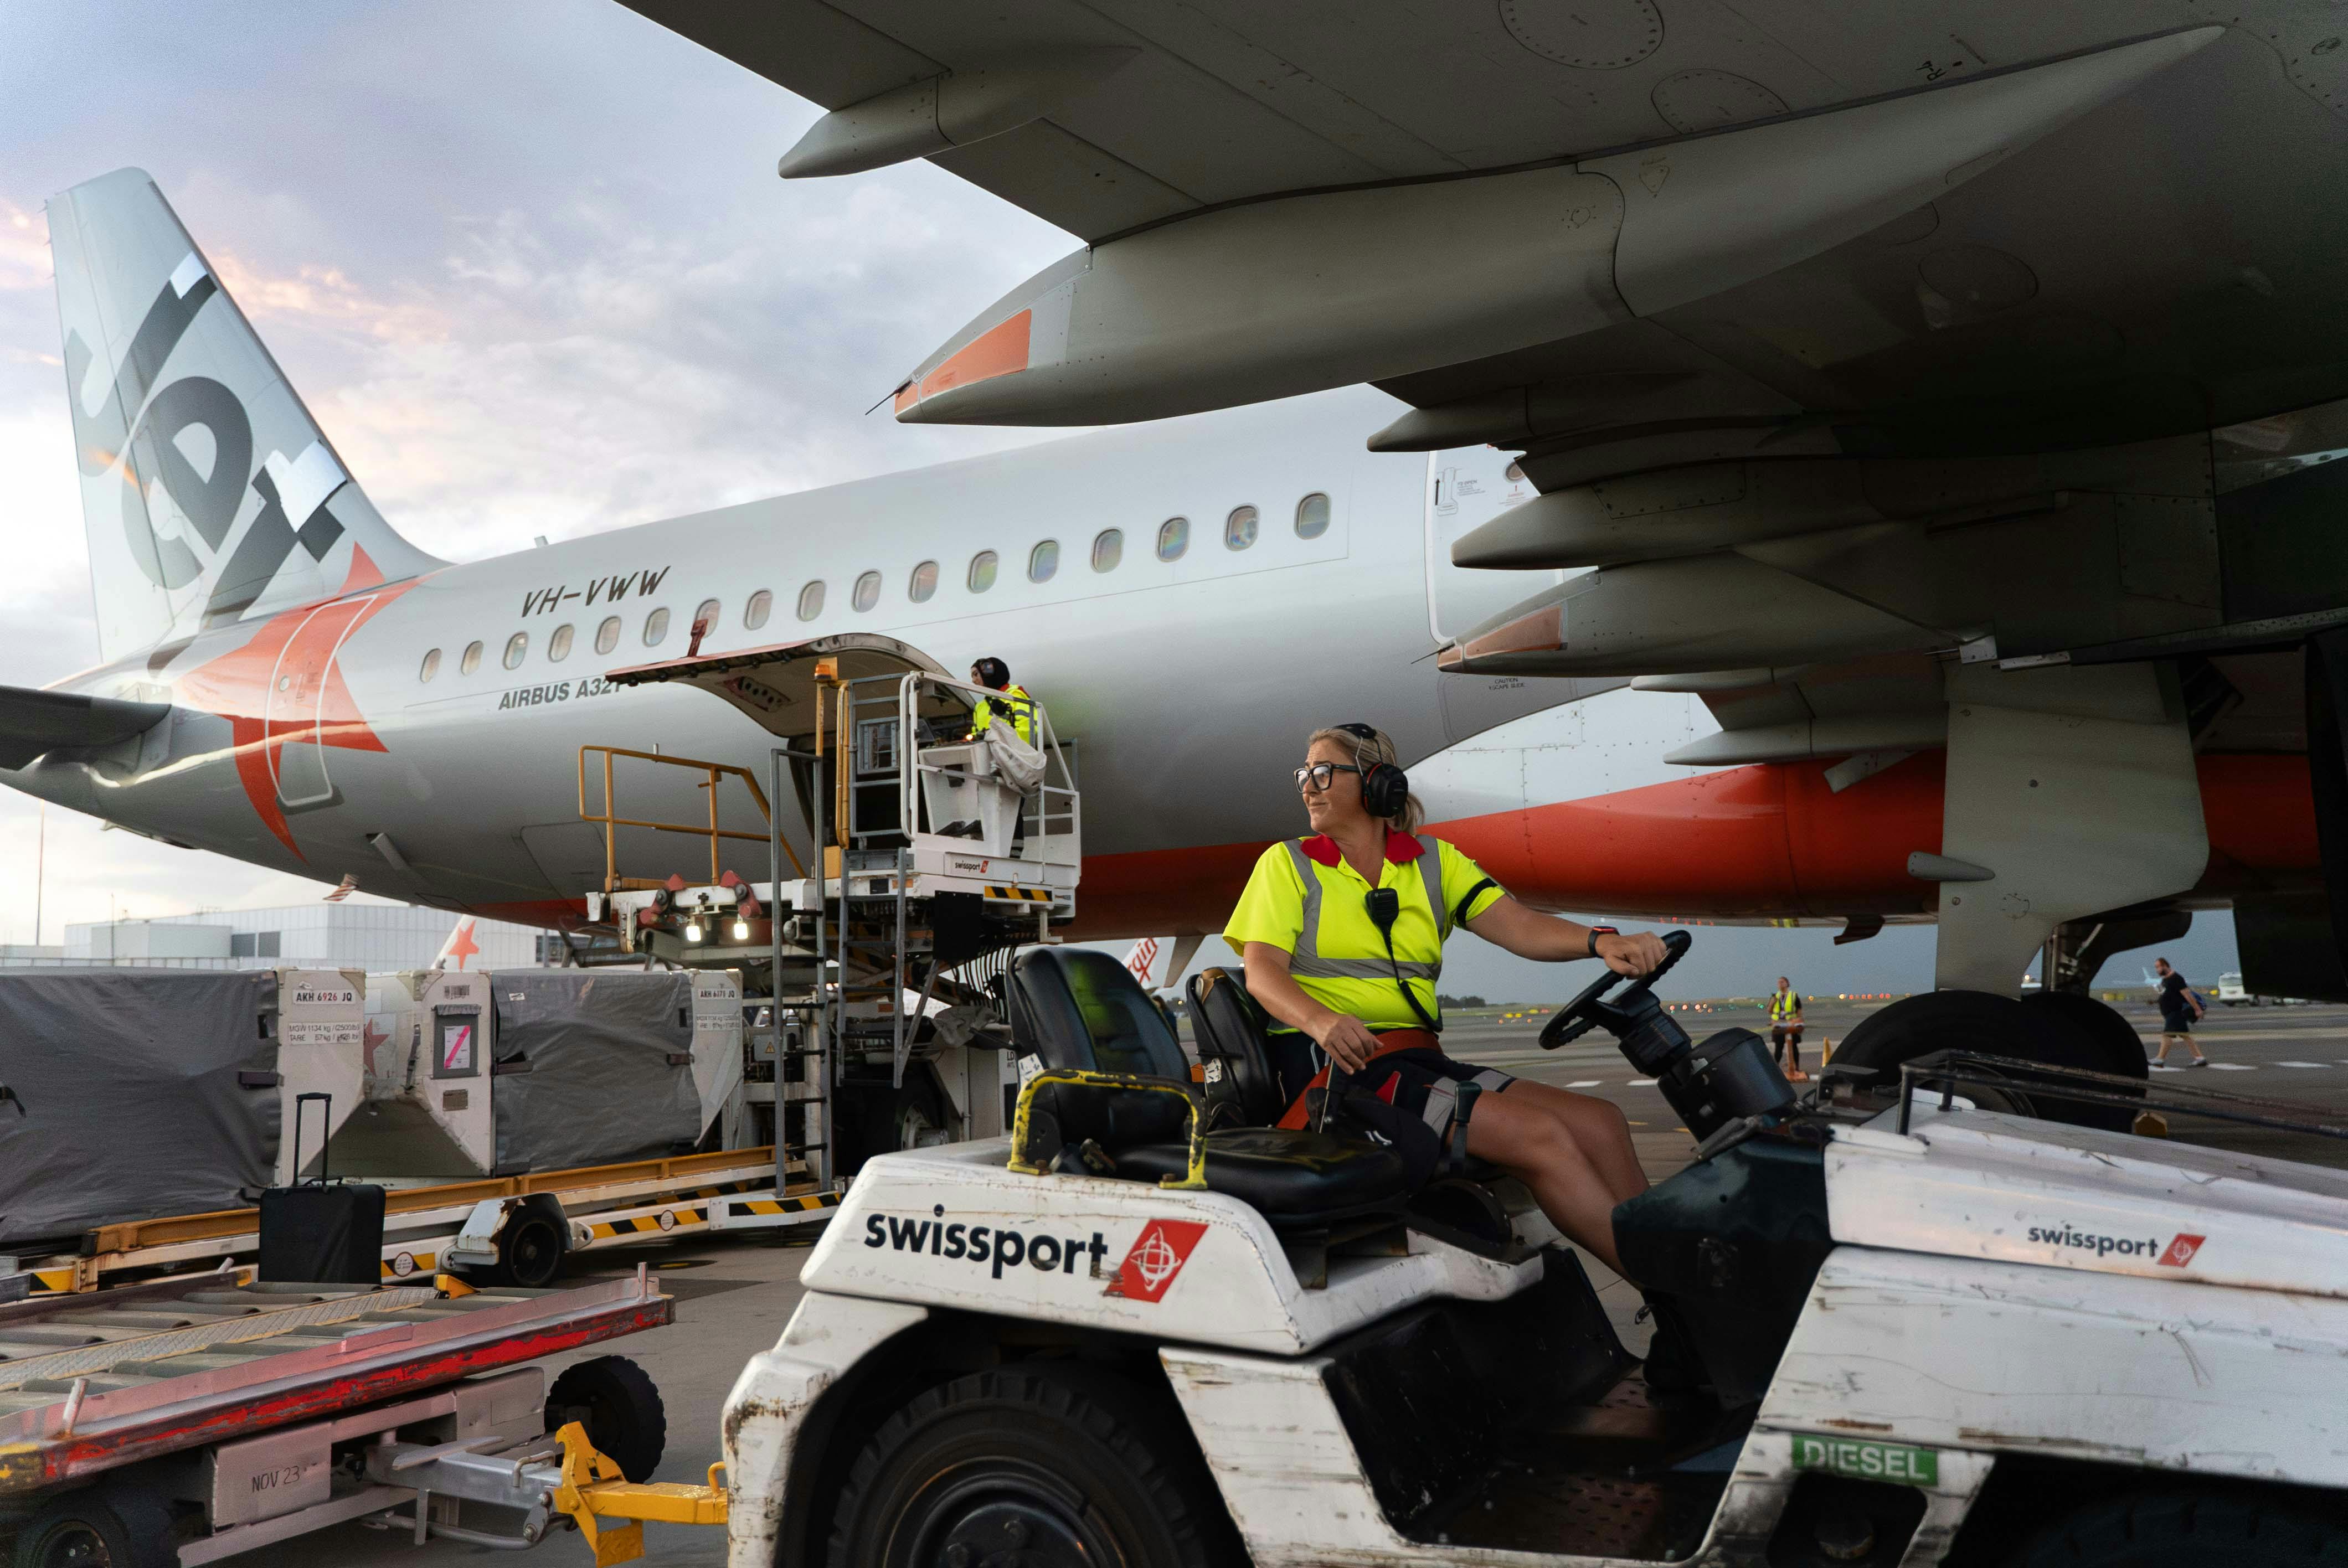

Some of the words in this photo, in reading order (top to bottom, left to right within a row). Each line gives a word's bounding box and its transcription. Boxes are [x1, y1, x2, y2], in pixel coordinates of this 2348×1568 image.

[522, 565, 671, 618] VH-VWW
[498, 682, 570, 710] AIRBUS
[955, 860, 980, 873] swissport
[296, 992, 315, 1002] AKH
[317, 992, 337, 1002] 6926
[342, 992, 352, 1002] JQ
[864, 1204, 1108, 1280] swissport
[2027, 1224, 2158, 1257] swissport
[1803, 1440, 1928, 1479] DIESEL
[251, 1471, 279, 1493] NOV
[283, 1465, 301, 1485] 23
